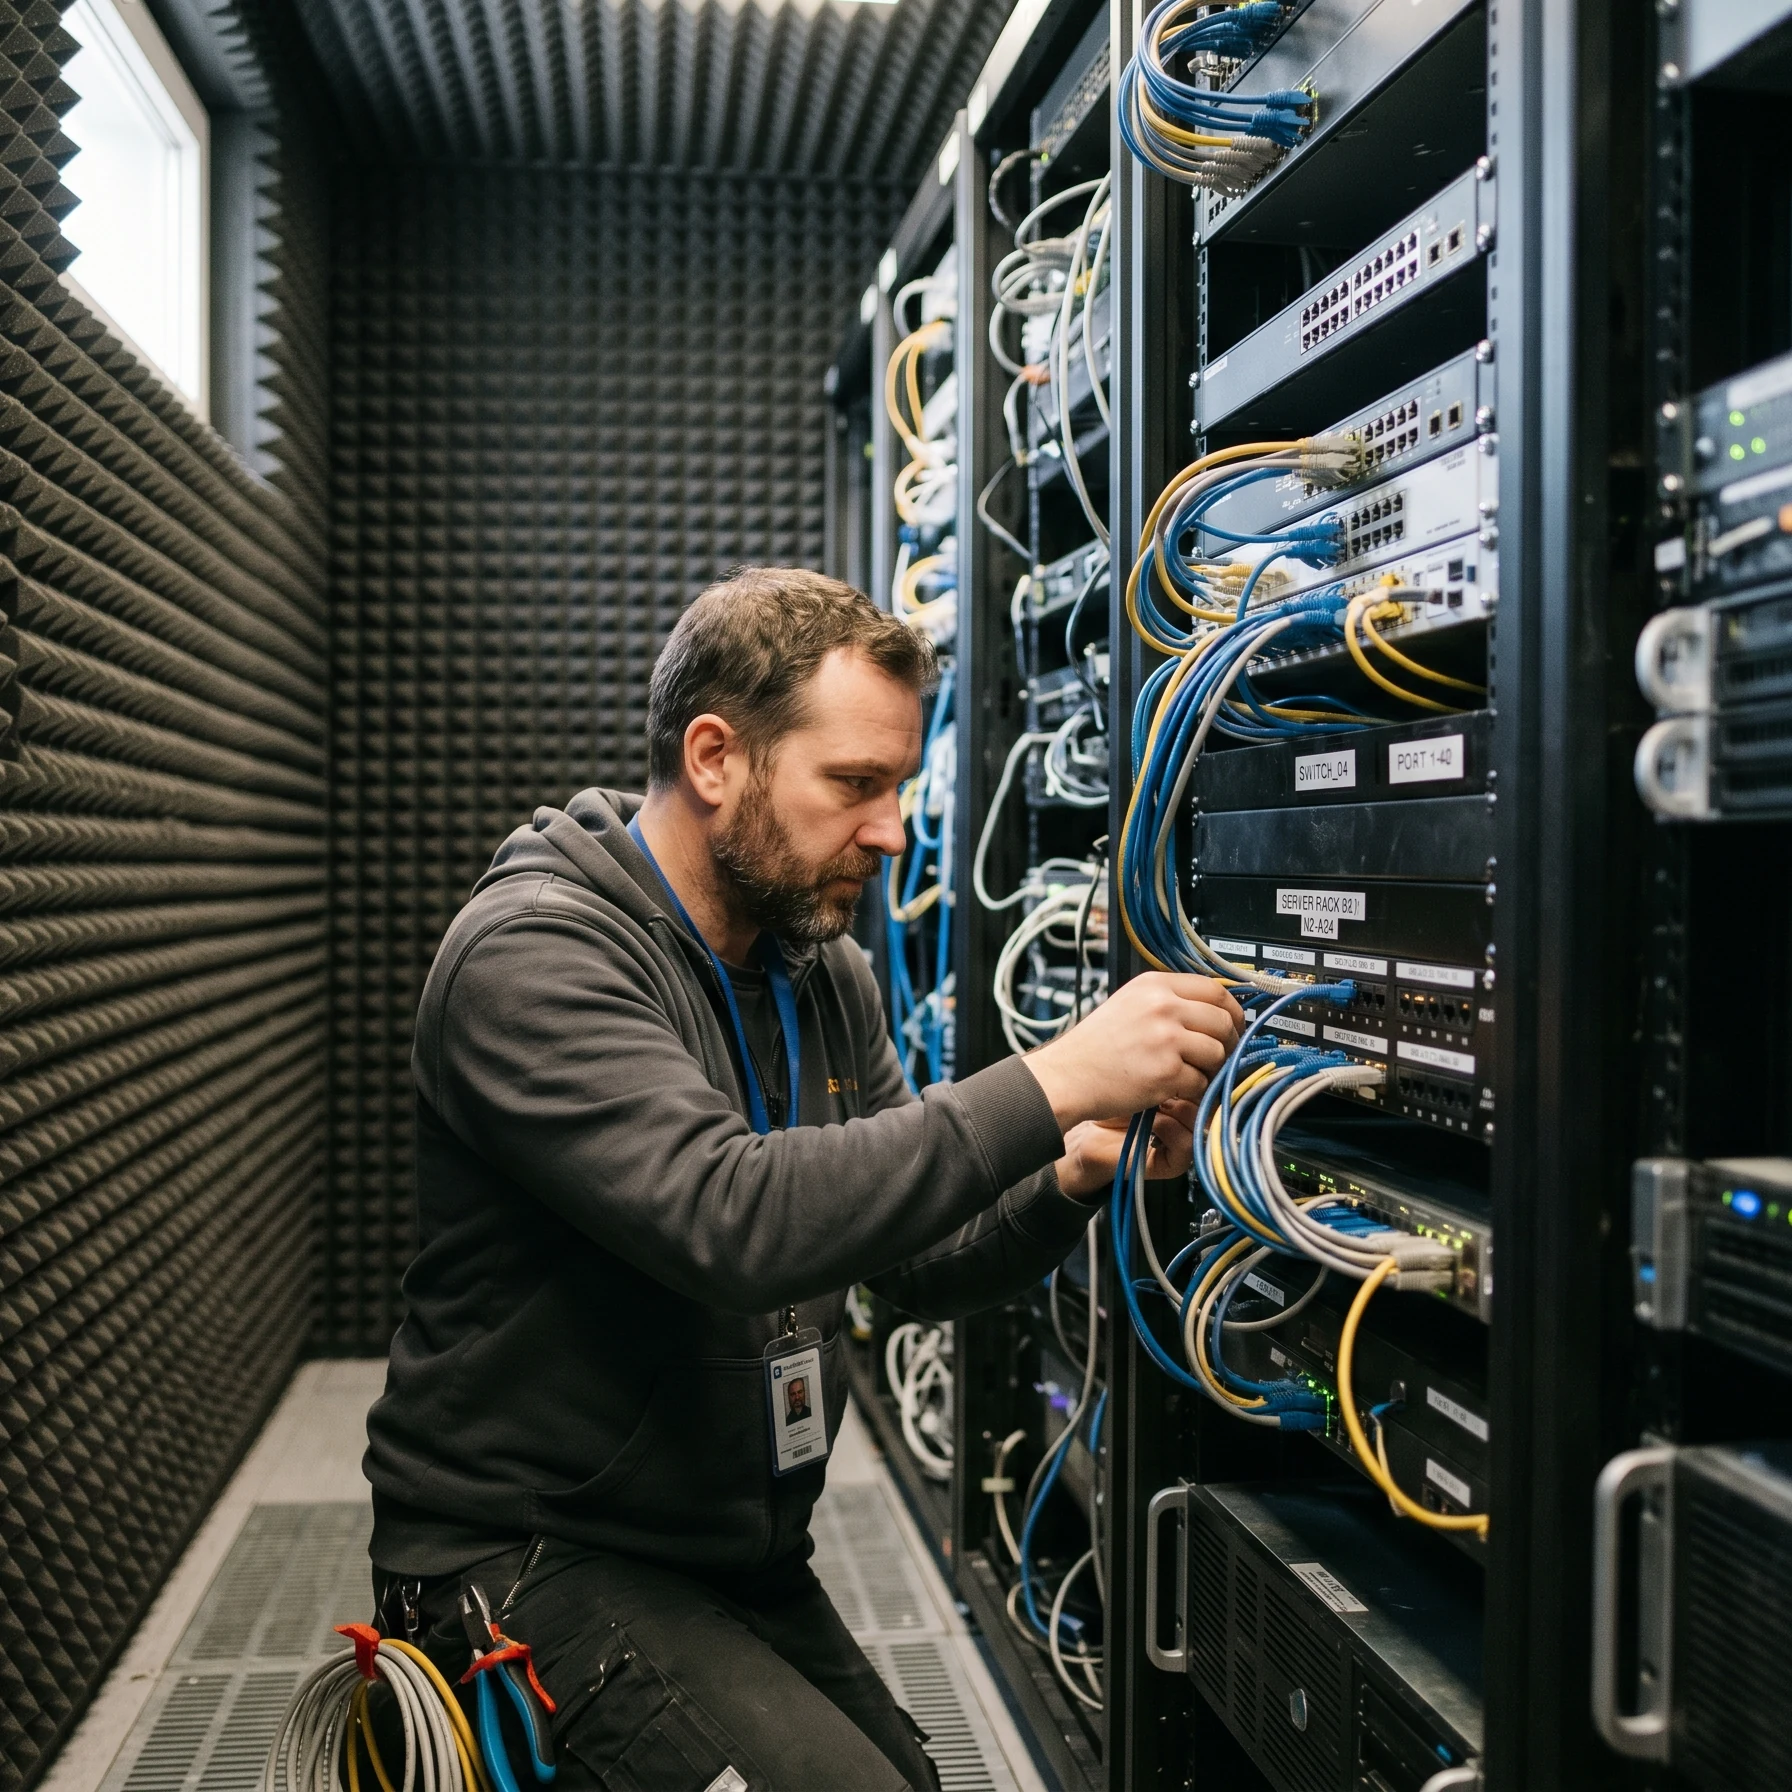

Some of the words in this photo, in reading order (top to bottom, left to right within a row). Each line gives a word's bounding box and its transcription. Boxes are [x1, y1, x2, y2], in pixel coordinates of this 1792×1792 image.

[1299, 761, 1348, 781] SWITCH_04
[1397, 751, 1426, 771] PORT
[1282, 894, 1314, 911] SERVER
